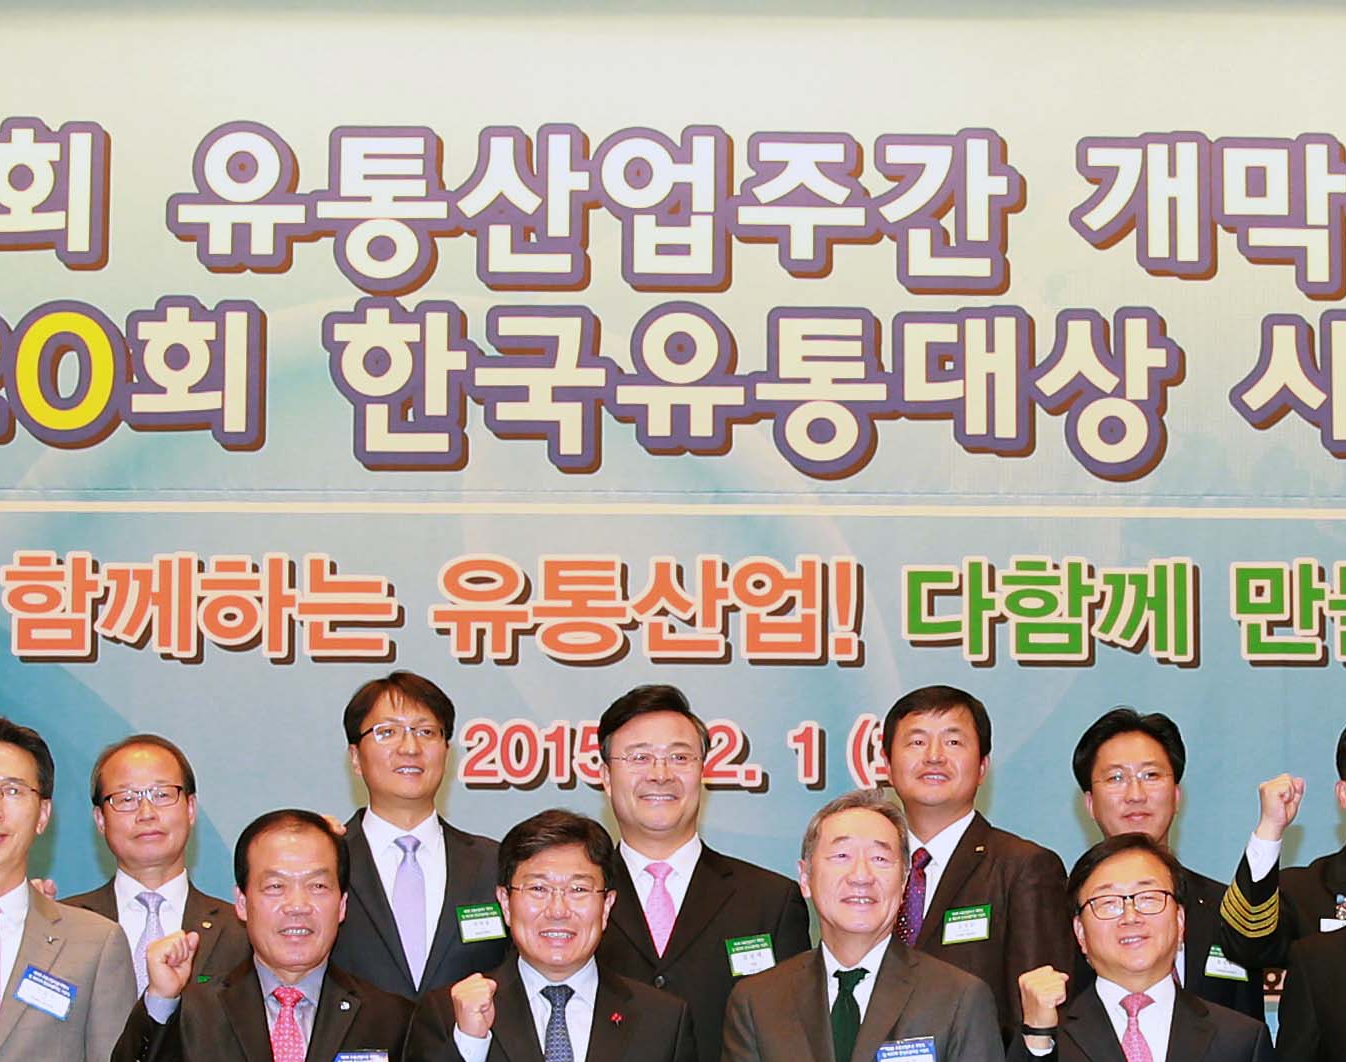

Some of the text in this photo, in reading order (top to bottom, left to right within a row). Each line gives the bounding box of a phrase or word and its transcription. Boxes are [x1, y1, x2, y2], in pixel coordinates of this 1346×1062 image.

[168, 120, 1024, 295] 유통산업주간
[321, 298, 1183, 480] 한국유통대상
[0, 550, 404, 663] 함께하는
[430, 554, 863, 668] 유통산업!
[902, 555, 1199, 668] 다함께
[700, 720, 764, 786] 2.
